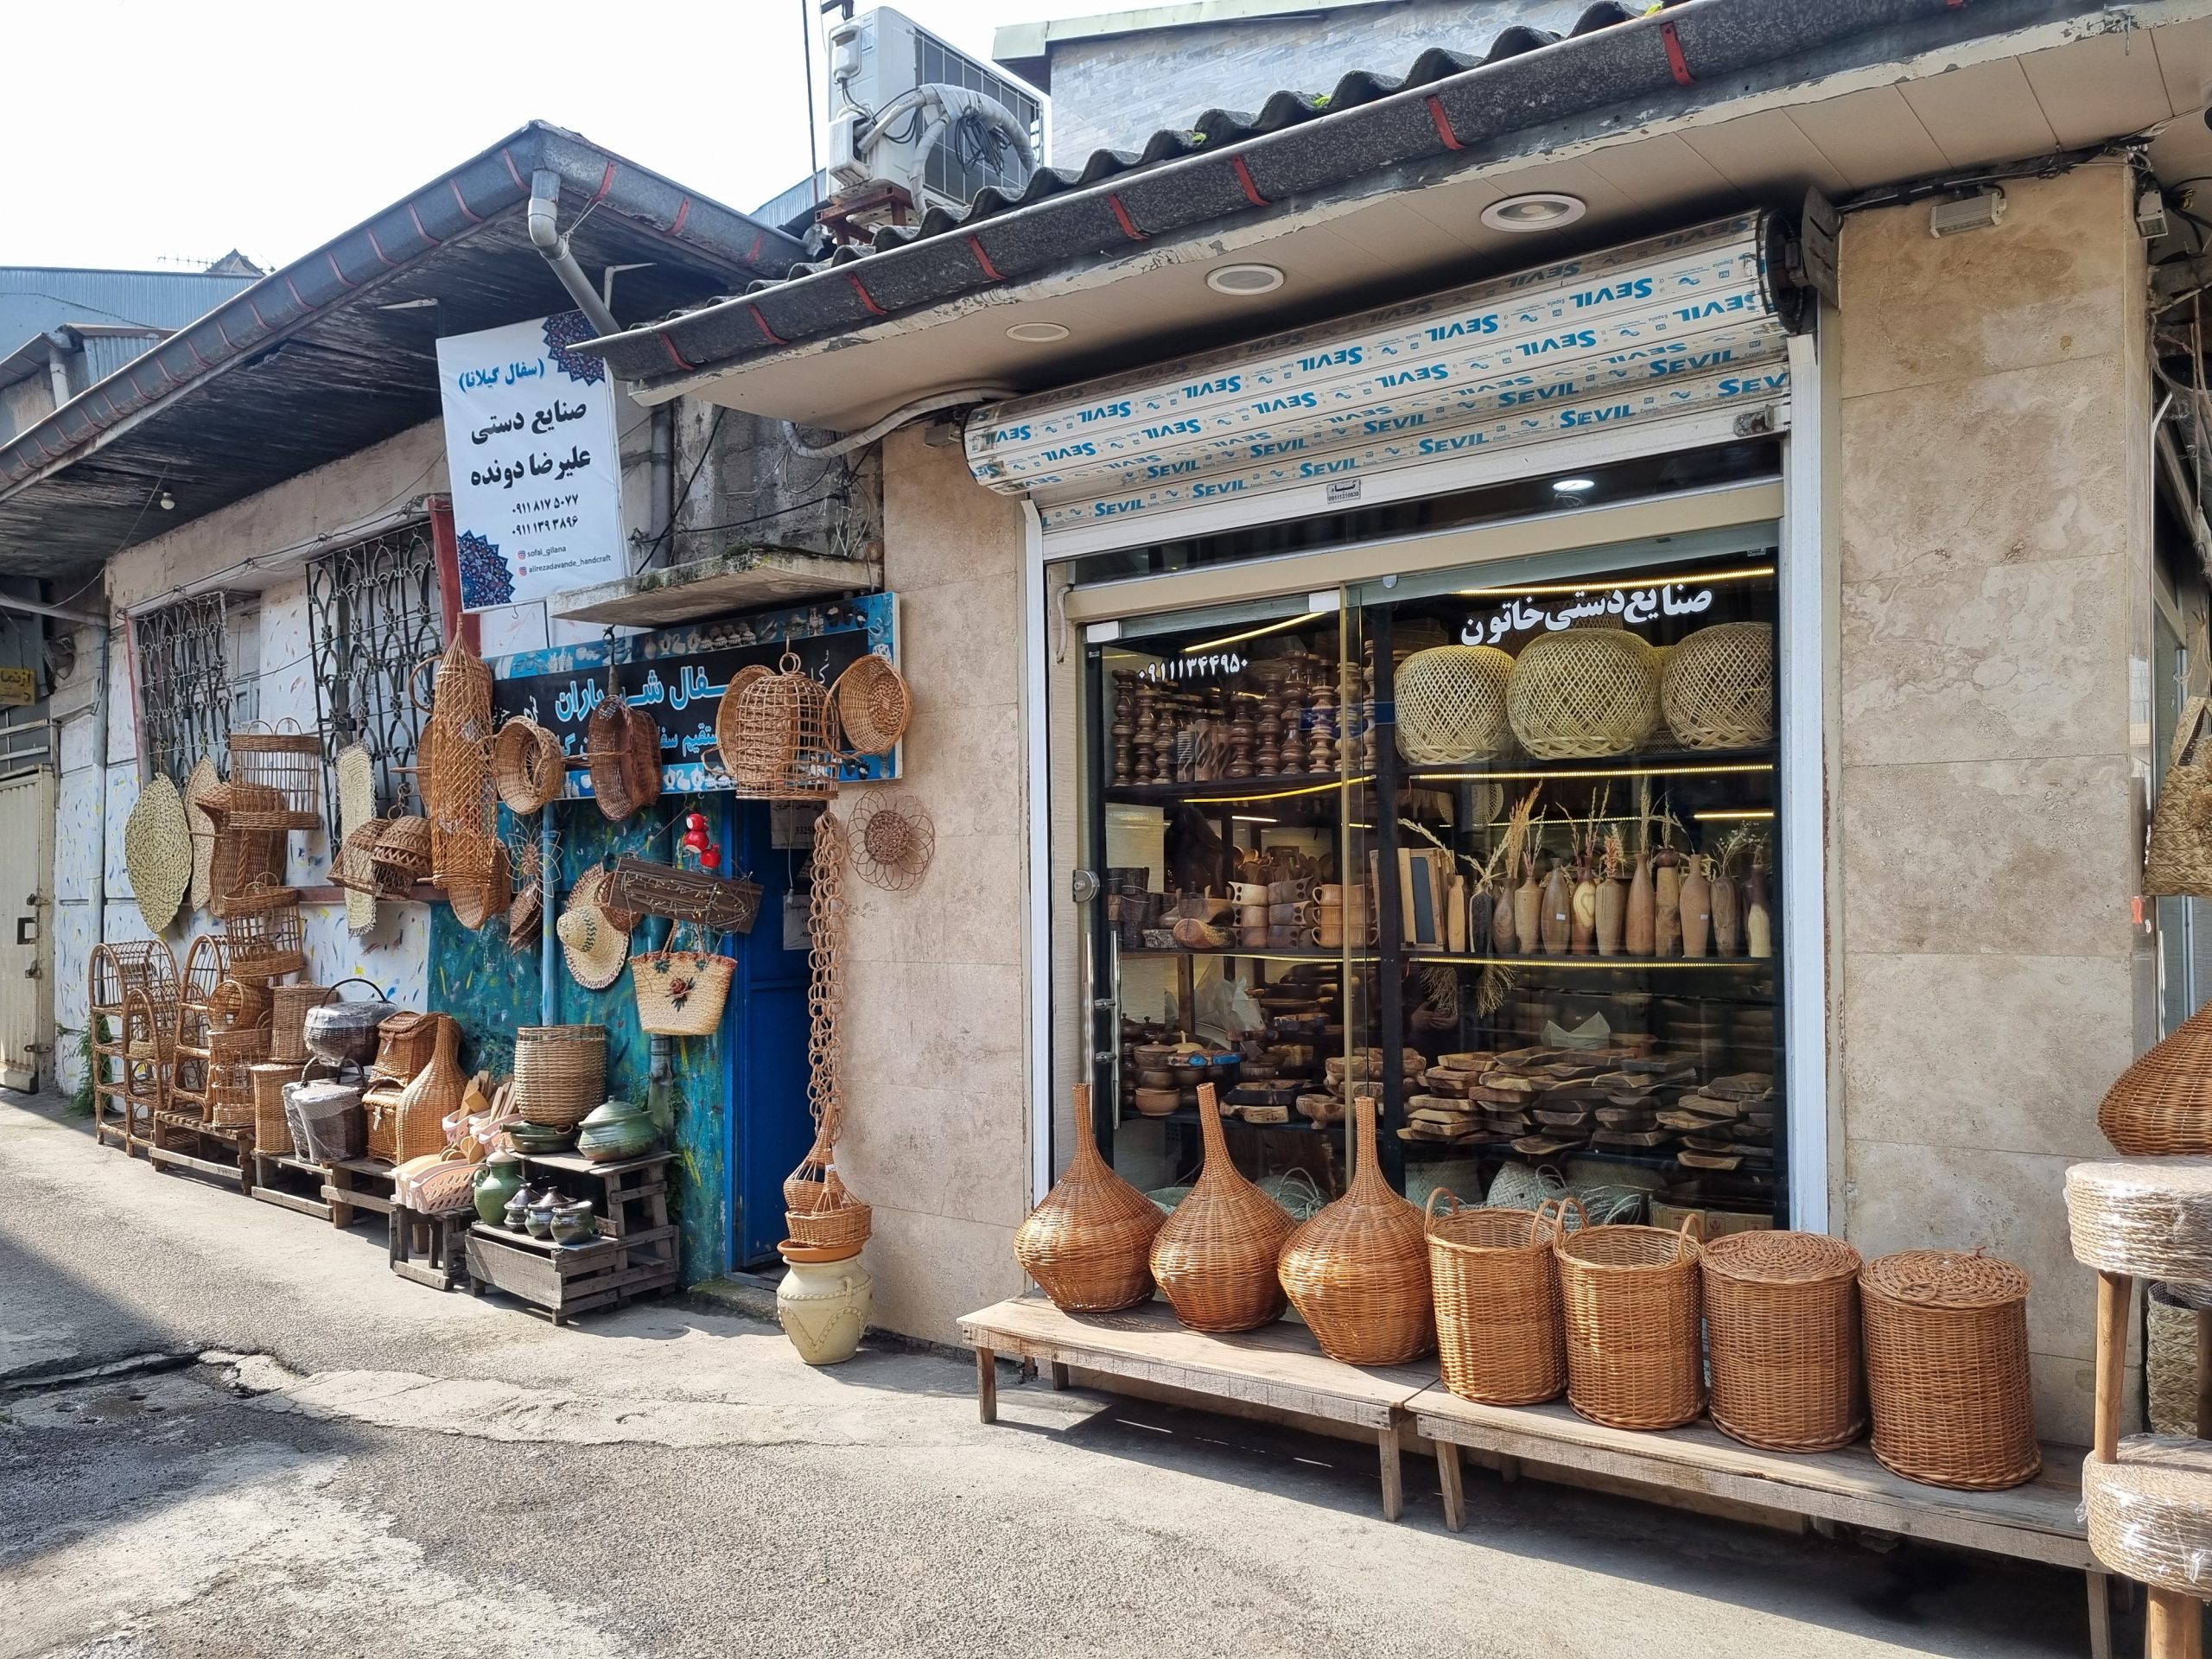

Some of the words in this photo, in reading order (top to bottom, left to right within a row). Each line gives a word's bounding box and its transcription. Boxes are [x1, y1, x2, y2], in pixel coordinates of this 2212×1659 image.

[1505, 261, 1582, 288] SEVIL
[1569, 277, 1654, 308] SEVIL
[1425, 314, 1499, 342] SEVIL
[1516, 329, 1597, 356] SEVIL
[1600, 342, 1688, 365] SEVIL
[1297, 346, 1363, 372] SEVIL
[1182, 375, 1242, 398] SEVIL
[1375, 364, 1449, 388] SEVIL
[1452, 376, 1535, 396] SEVIL
[1077, 401, 1132, 423] SEVIL
[1147, 460, 1201, 479] SEVIL
[1249, 438, 1309, 460] SEVIL
[1363, 413, 1429, 435] SEVIL
[1497, 382, 1580, 409] SEVIL
[1649, 350, 1740, 378] SEVIL
[1252, 391, 1318, 414] SEVIL
[1323, 406, 1394, 423] SEVIL
[471, 411, 525, 445] دستی
[531, 398, 588, 435] صنایع
[1141, 418, 1202, 440] SEVIL
[1041, 442, 1097, 461] SEVIL
[1094, 499, 1147, 518] SEVIL
[1192, 480, 1248, 499] SEVIL
[1299, 458, 1360, 479] SEVIL
[1419, 433, 1490, 456] SEVIL
[1559, 404, 1637, 429] SEVIL
[1717, 372, 1789, 397] SEV
[1207, 432, 1273, 448] SEVIL
[471, 459, 524, 489] دونده
[528, 445, 591, 481] علیرضا
[1103, 454, 1162, 469] SEVIL
[526, 545, 567, 558] sofal_gilana
[1545, 590, 1625, 632] دستی
[1623, 583, 1713, 623] صنایع
[1460, 595, 1546, 645] خاتون
[1138, 652, 1249, 683] ۰۹۱۱۱۳۴۴۹۵۰
[670, 666, 730, 710] فال
